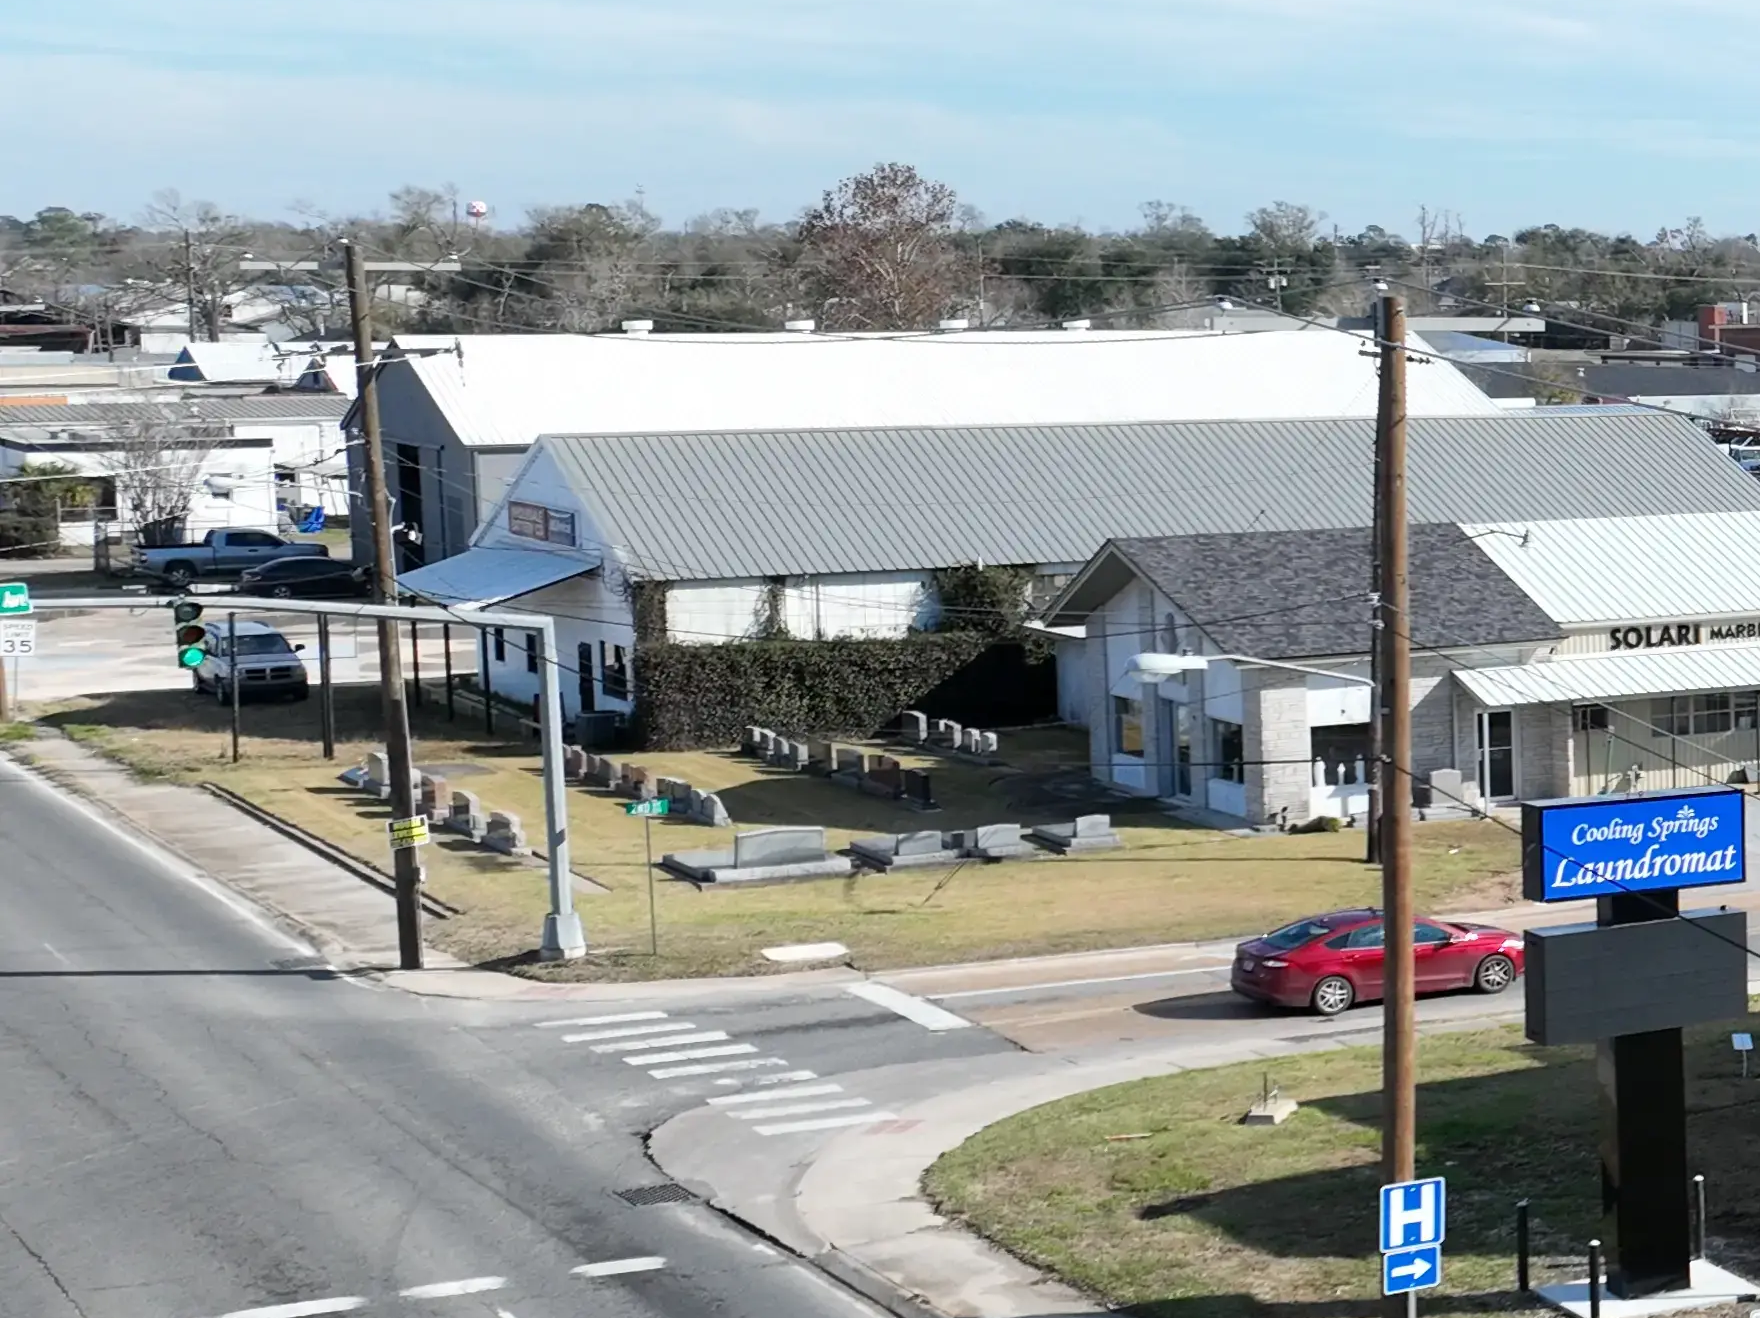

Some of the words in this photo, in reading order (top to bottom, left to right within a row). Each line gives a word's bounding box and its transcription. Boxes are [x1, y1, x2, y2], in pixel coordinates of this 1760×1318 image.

[3, 640, 32, 653] 35
[1610, 623, 1701, 650] SOLARI
[1571, 818, 1644, 846] Cooling
[1647, 815, 1719, 842] Springs
[1551, 844, 1737, 888] Laundromat
[1389, 1183, 1435, 1247] H
